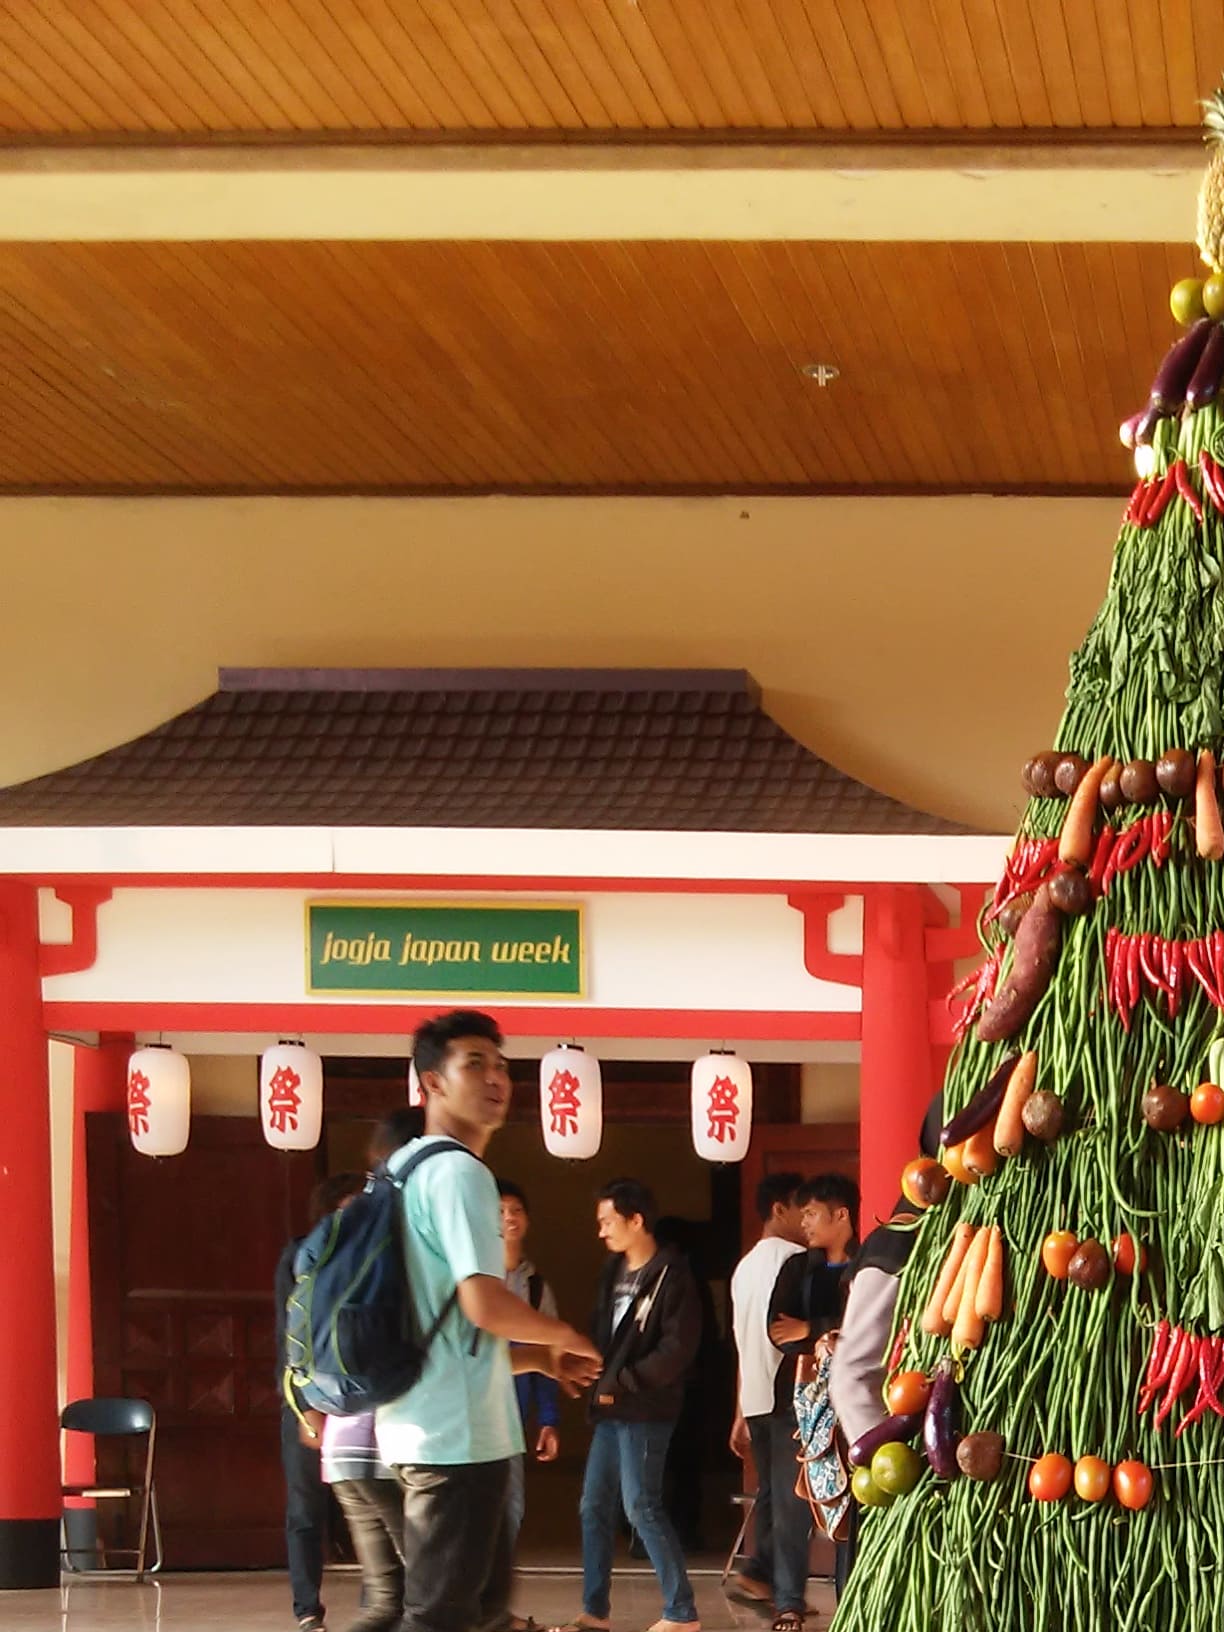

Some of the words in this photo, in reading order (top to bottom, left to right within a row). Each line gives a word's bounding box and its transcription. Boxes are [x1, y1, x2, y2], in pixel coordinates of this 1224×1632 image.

[320, 932, 391, 966] jogja
[398, 932, 480, 966] japan
[491, 935, 571, 964] week
[268, 1065, 303, 1134] 祭
[548, 1068, 582, 1137] 祭
[707, 1075, 741, 1144] 祭
